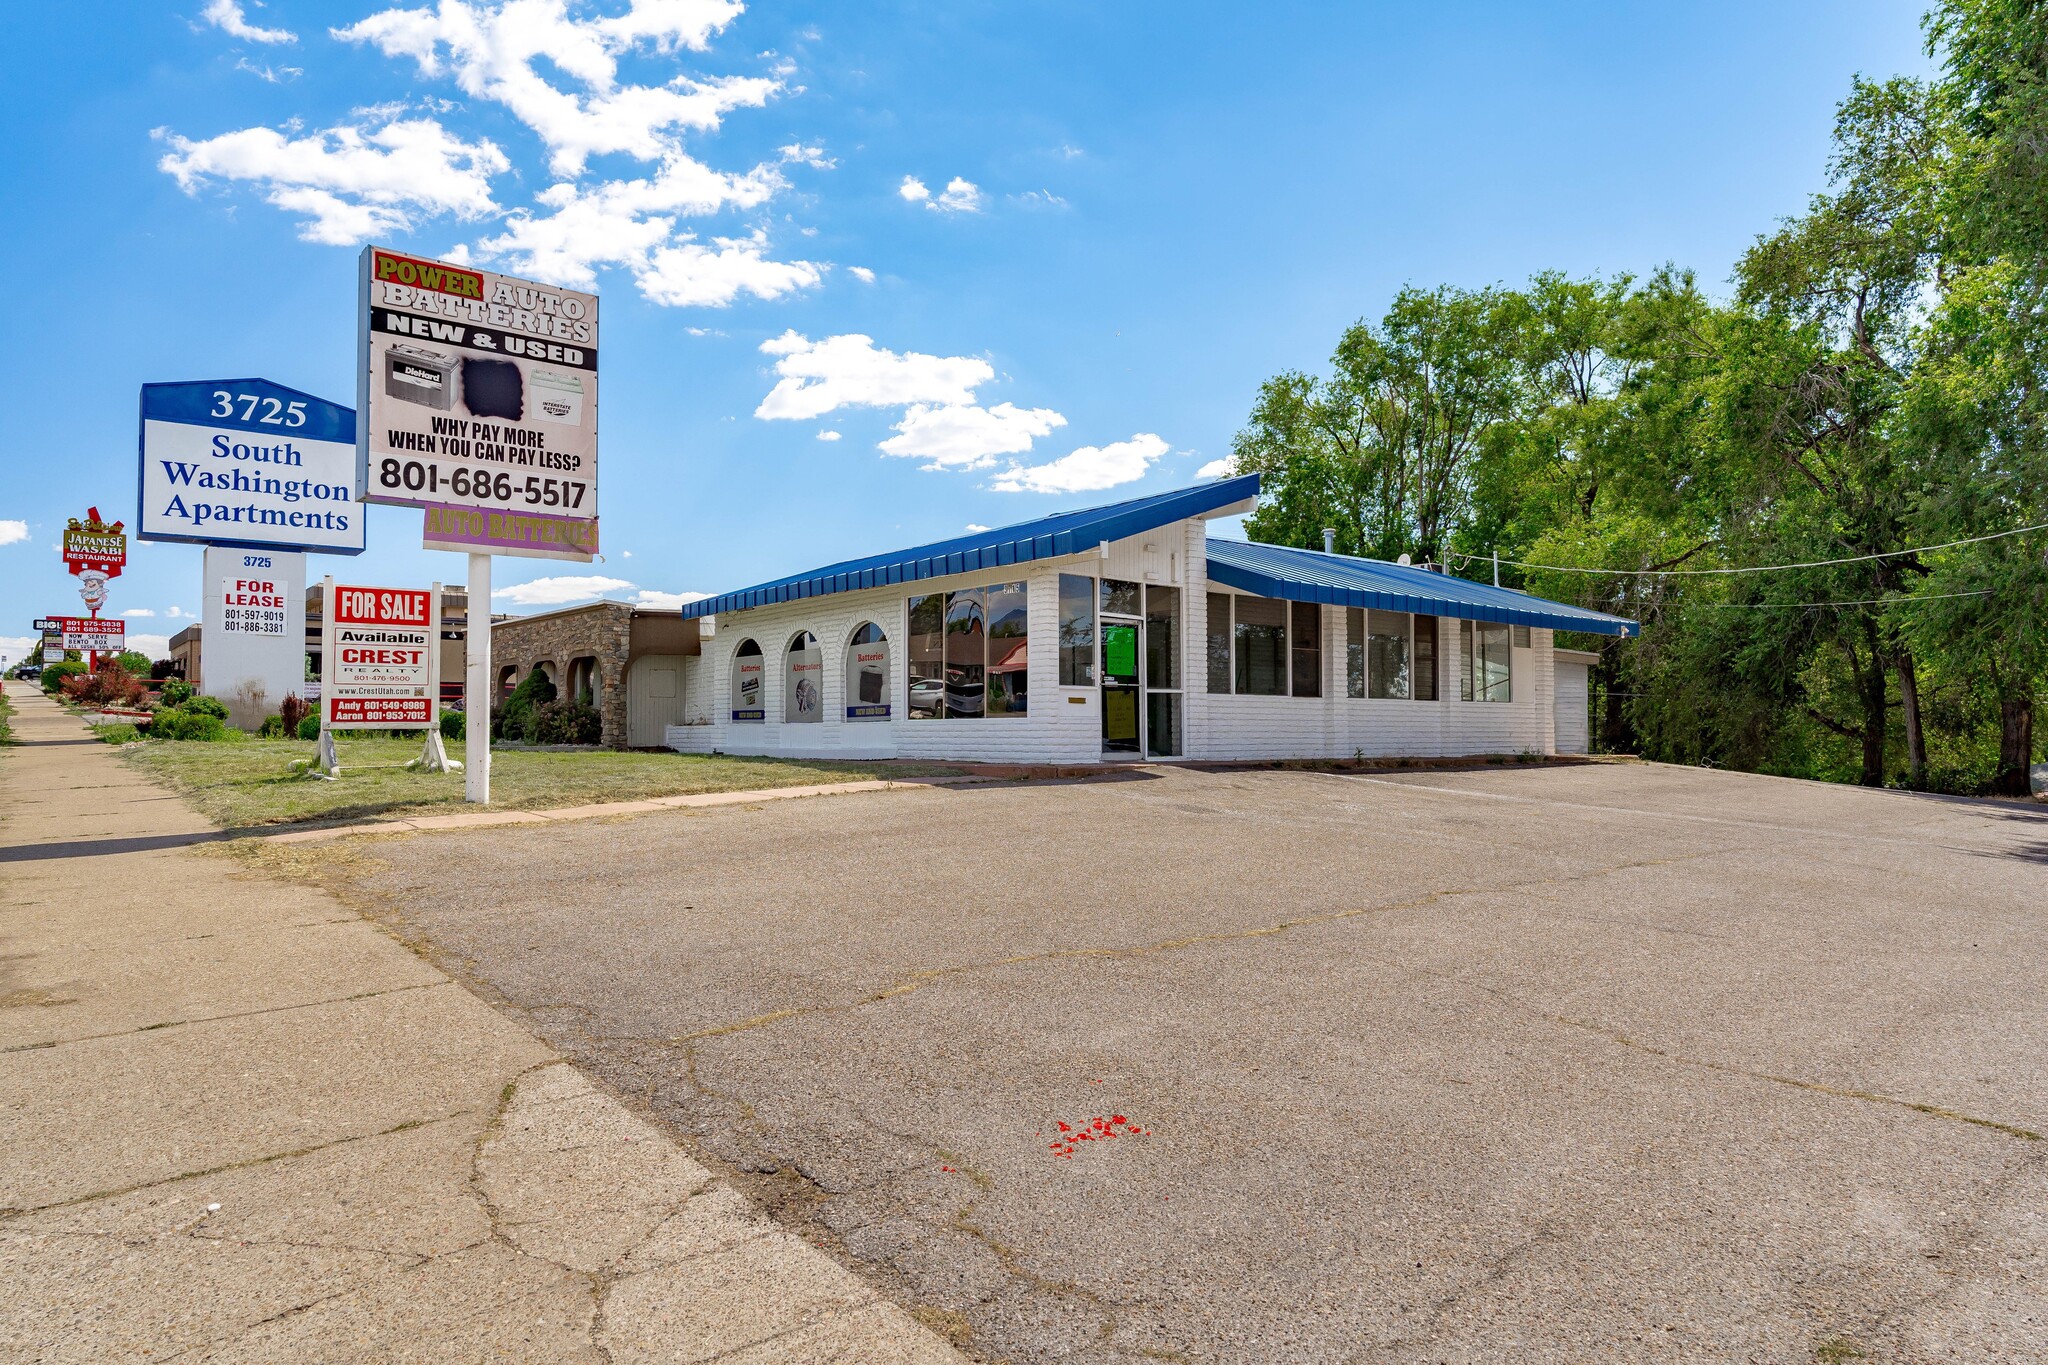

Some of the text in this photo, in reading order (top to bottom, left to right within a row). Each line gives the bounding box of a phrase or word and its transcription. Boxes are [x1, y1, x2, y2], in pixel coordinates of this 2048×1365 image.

[378, 256, 586, 320] POWER AUTO
[383, 281, 590, 344] BATTERIES
[387, 313, 584, 366] NEW & USED
[405, 366, 440, 382] DieHard
[210, 390, 308, 427] 3725
[542, 401, 572, 410] INTERSTATE
[543, 406, 570, 415] BATTERIES
[431, 416, 544, 448] WHY PAY MORE
[212, 434, 304, 466] South
[388, 430, 580, 472] WHEN YOU CAN PAY LESS?
[160, 460, 350, 502] Washington
[380, 458, 586, 509] 801-686-5517
[162, 494, 349, 531] Apartments
[426, 508, 598, 547] AUTO BATTERIES
[68, 533, 122, 547] JAPANESE
[66, 552, 122, 562] RESTAURANT
[68, 544, 122, 556] WASABI
[244, 556, 272, 568] 3725
[236, 580, 274, 593] FOR
[226, 594, 284, 608] LEASE
[342, 591, 424, 621] FOR SALE
[225, 609, 284, 622] 801-597-9019
[225, 621, 283, 632] 801-886-3381
[341, 631, 424, 644] Available
[342, 648, 424, 664] CREST
[858, 652, 884, 662] Batteries
[792, 663, 822, 672] Alternators
[338, 687, 410, 696] www.CrestUtah.com
[338, 701, 361, 711] Andy
[336, 711, 364, 720] Aaron
